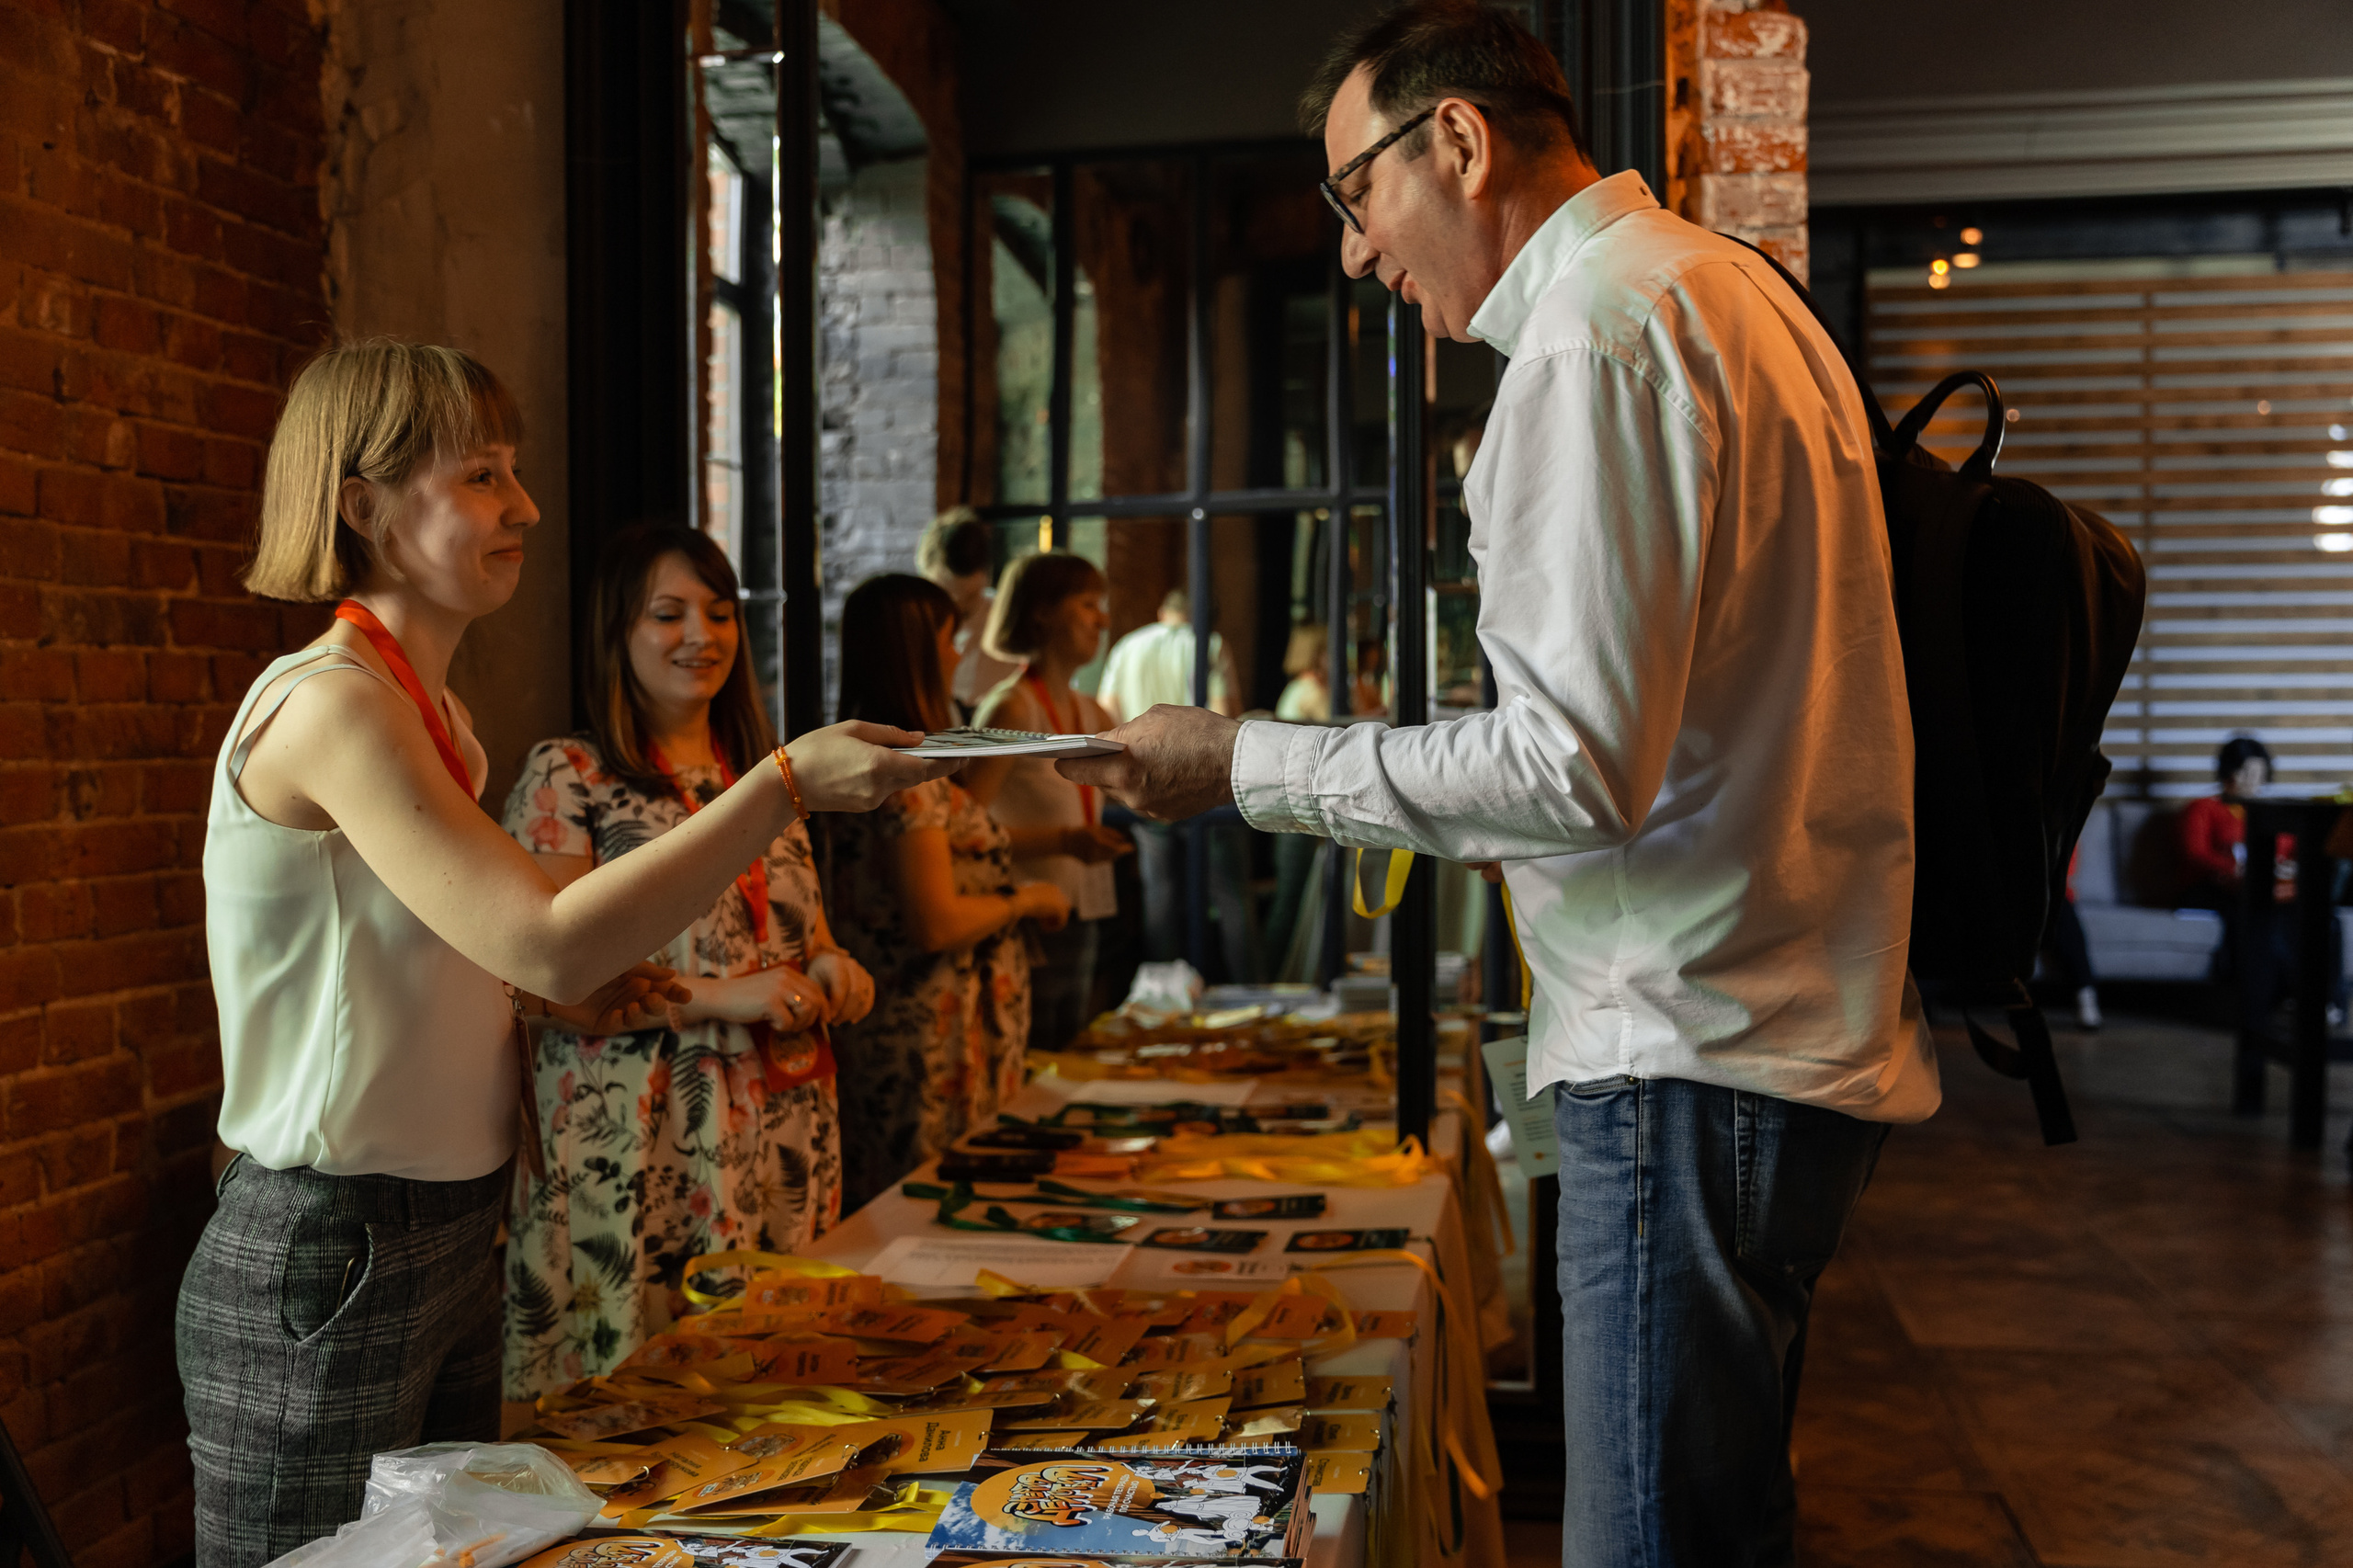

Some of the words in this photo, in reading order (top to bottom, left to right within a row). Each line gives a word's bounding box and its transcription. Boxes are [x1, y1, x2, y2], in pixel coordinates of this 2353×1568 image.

[918, 1422, 939, 1462] Данилова
[936, 1429, 950, 1450] Анна
[1312, 1458, 1330, 1486] Станислав
[1103, 1494, 1120, 1519] РАБОЧАЯ
[1113, 1473, 1130, 1495] ТЕТРАДЬ
[1122, 1480, 1140, 1505] СЧАСТЬЮ
[1119, 1504, 1130, 1513] ПО
